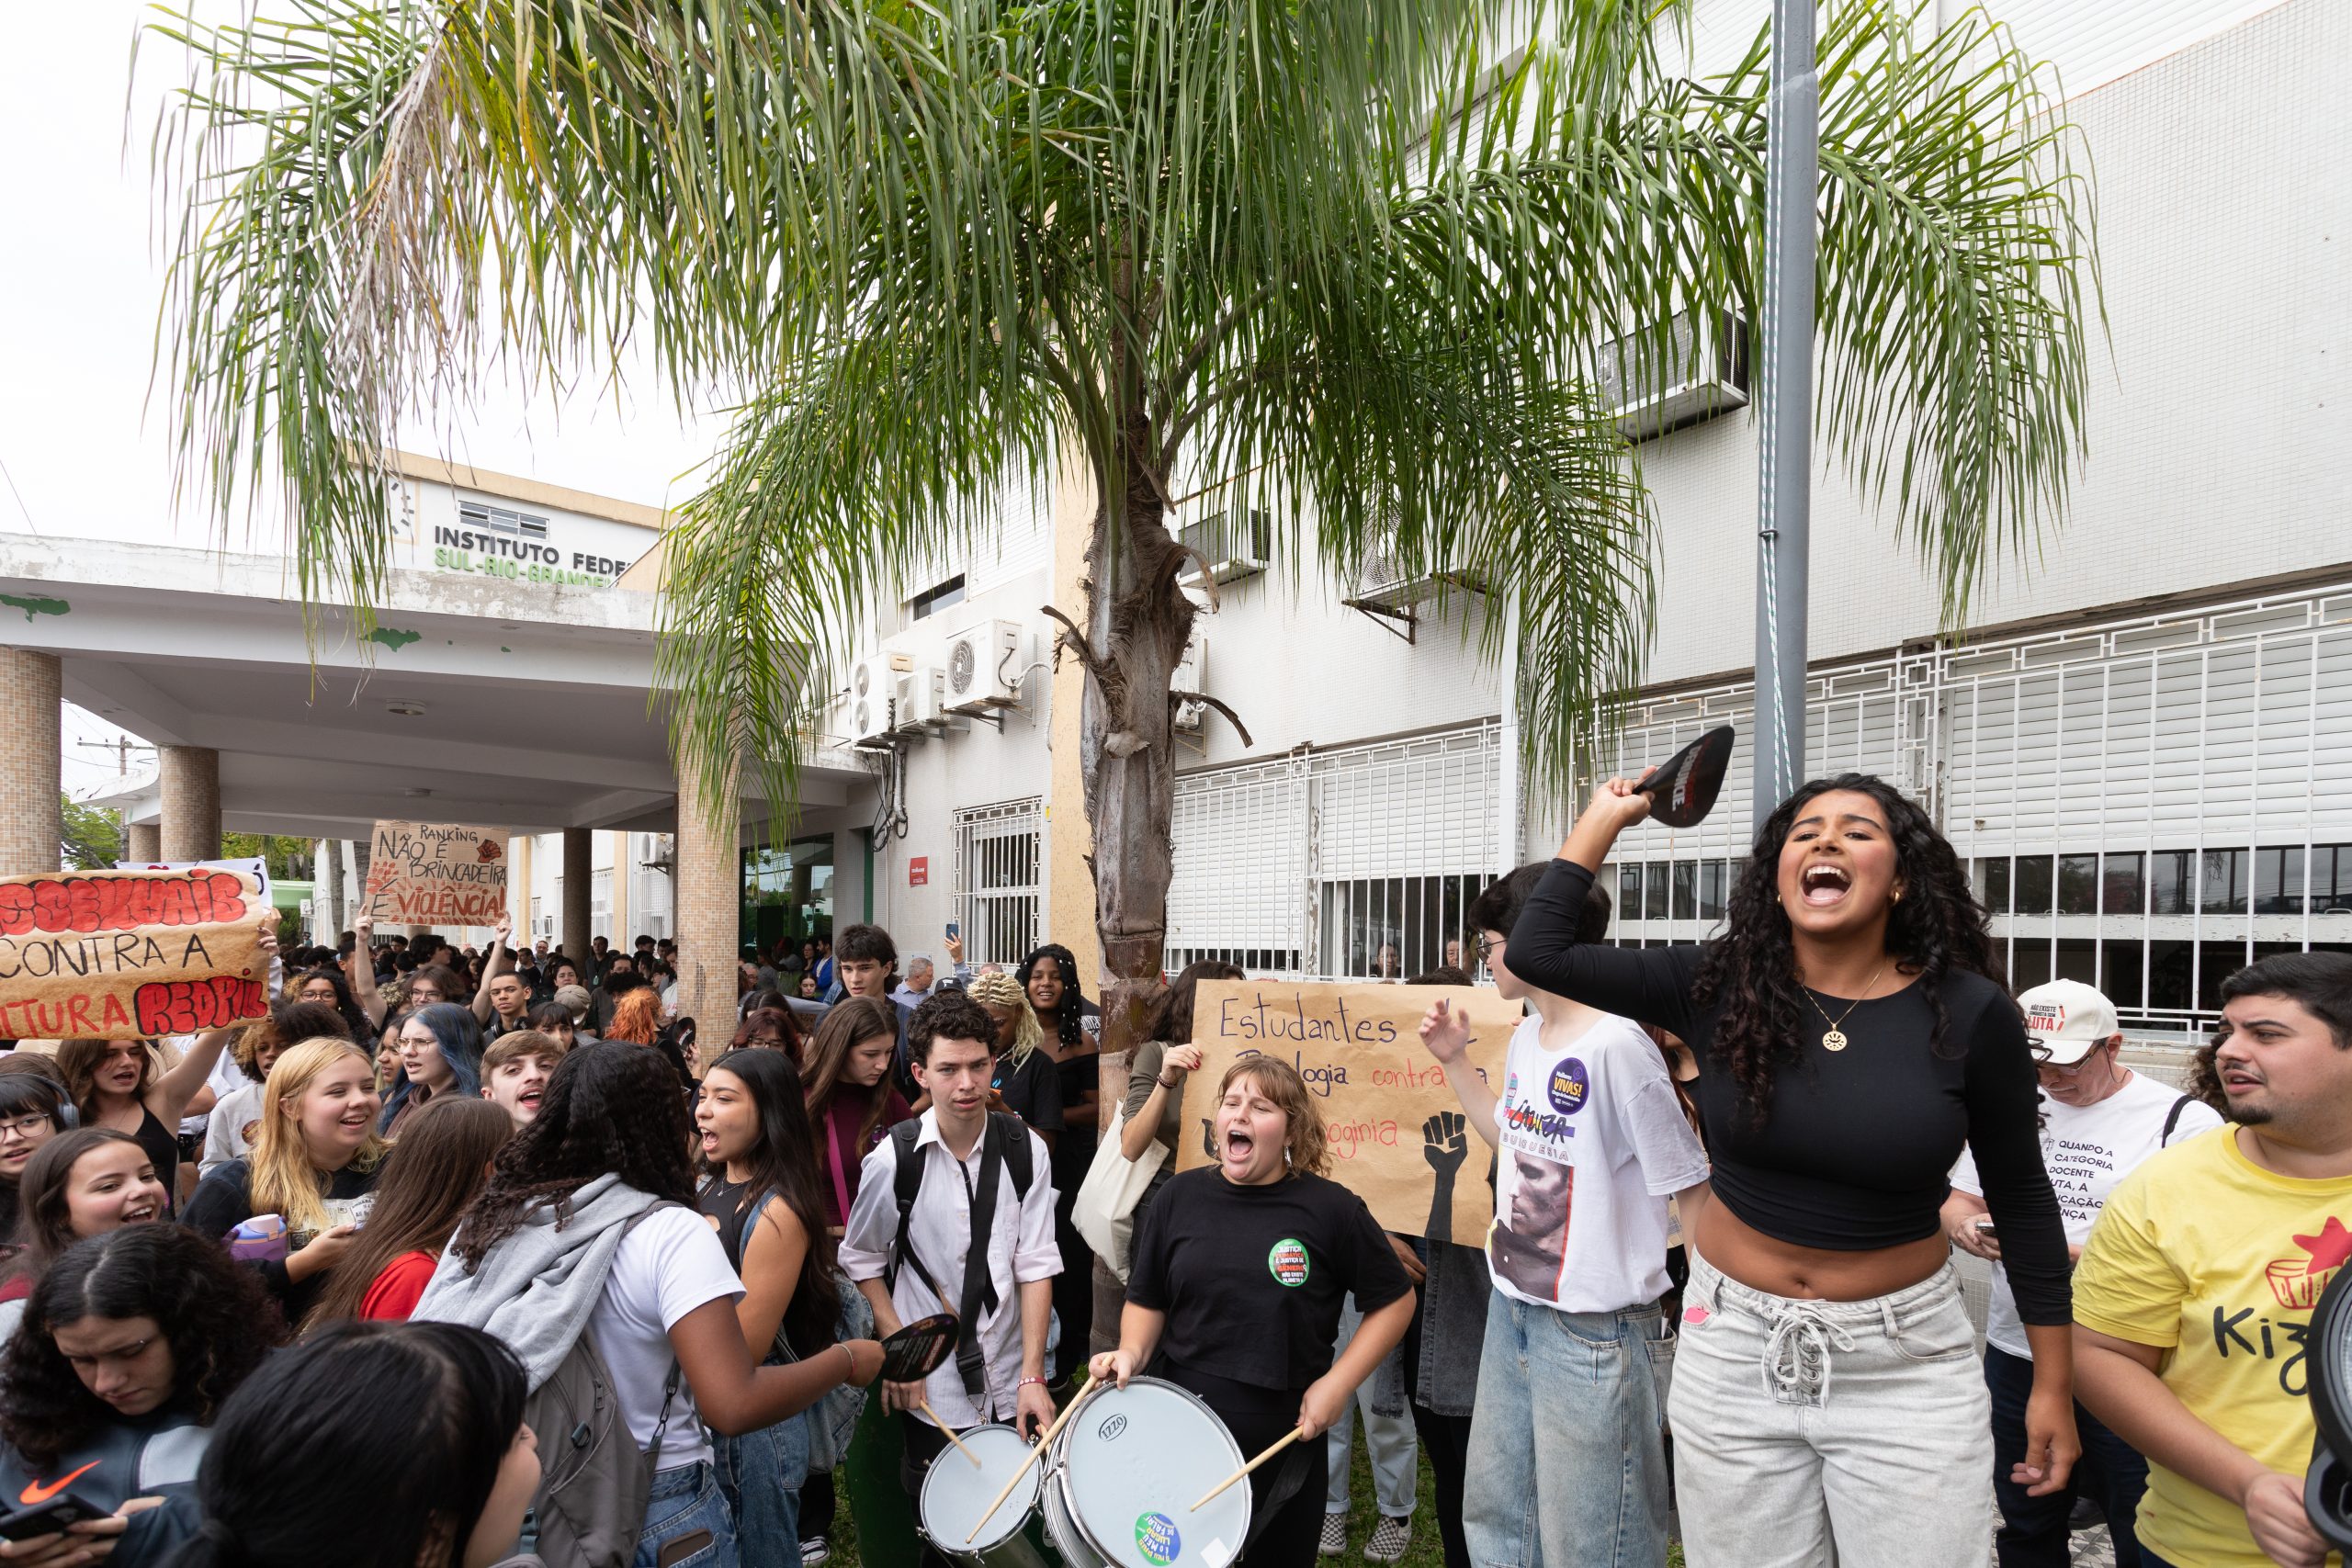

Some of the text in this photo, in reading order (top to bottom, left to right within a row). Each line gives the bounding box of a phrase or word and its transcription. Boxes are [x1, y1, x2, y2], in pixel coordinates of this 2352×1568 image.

[435, 525, 632, 577] INSTITUTO FEDE
[435, 547, 612, 588] SUL-RIO-GRANDE
[379, 830, 449, 860] NÃO É
[409, 858, 507, 886] BRINCADEIRA
[370, 878, 505, 919] É VIOLÊNCIA!
[0, 933, 213, 978] CONTRA A
[0, 992, 130, 1038] LTURA
[1220, 992, 1397, 1043] Estudantes
[2028, 1015, 2053, 1031] LUTA
[1373, 1057, 1446, 1089] contra
[1555, 1077, 1582, 1097] VIVAS!
[1326, 1118, 1398, 1160] oginia
[2059, 1140, 2103, 1155] QUANDO
[2049, 1167, 2095, 1179] DOCENTE
[2054, 1154, 2113, 1171] CATEGORIA
[2050, 1179, 2088, 1192] UTA, A
[2057, 1194, 2103, 1209] CAÇÃO
[2060, 1208, 2087, 1221] NÇA
[2213, 1306, 2310, 1396] Kiz
[1102, 1416, 1124, 1439] IZZO
